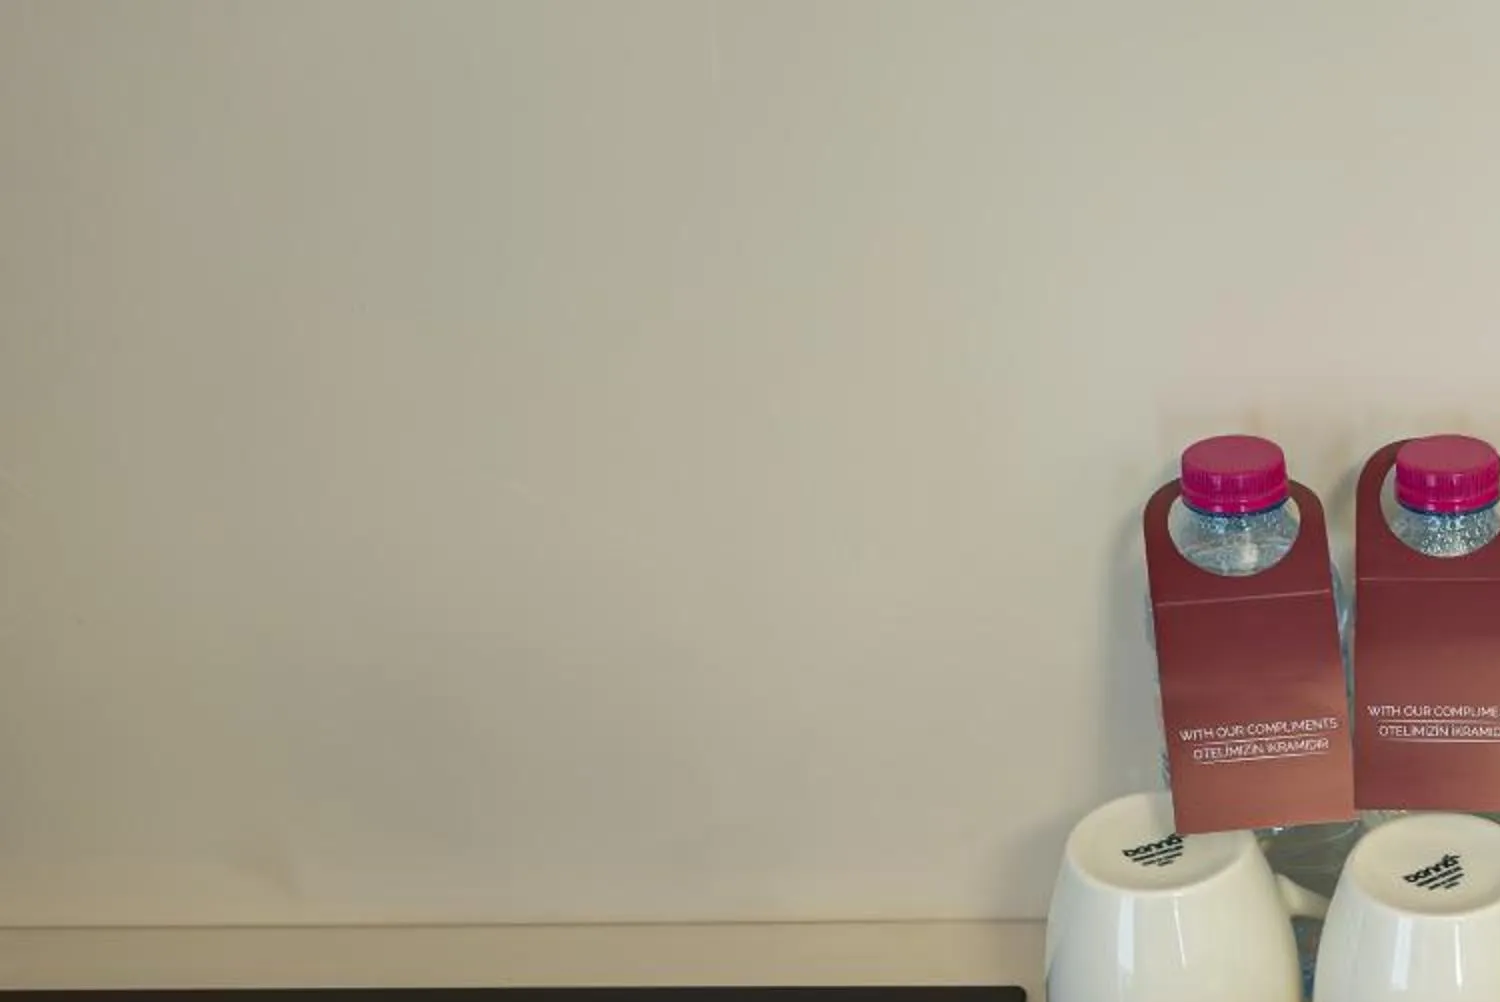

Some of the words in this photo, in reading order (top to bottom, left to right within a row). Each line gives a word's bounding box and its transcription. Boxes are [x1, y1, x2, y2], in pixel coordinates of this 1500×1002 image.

[1368, 704, 1401, 717] WITH
[1403, 705, 1431, 717] OUR
[1179, 727, 1213, 742] WITH
[1216, 724, 1244, 738] OUR
[1247, 717, 1338, 735] COMPLIMENTS
